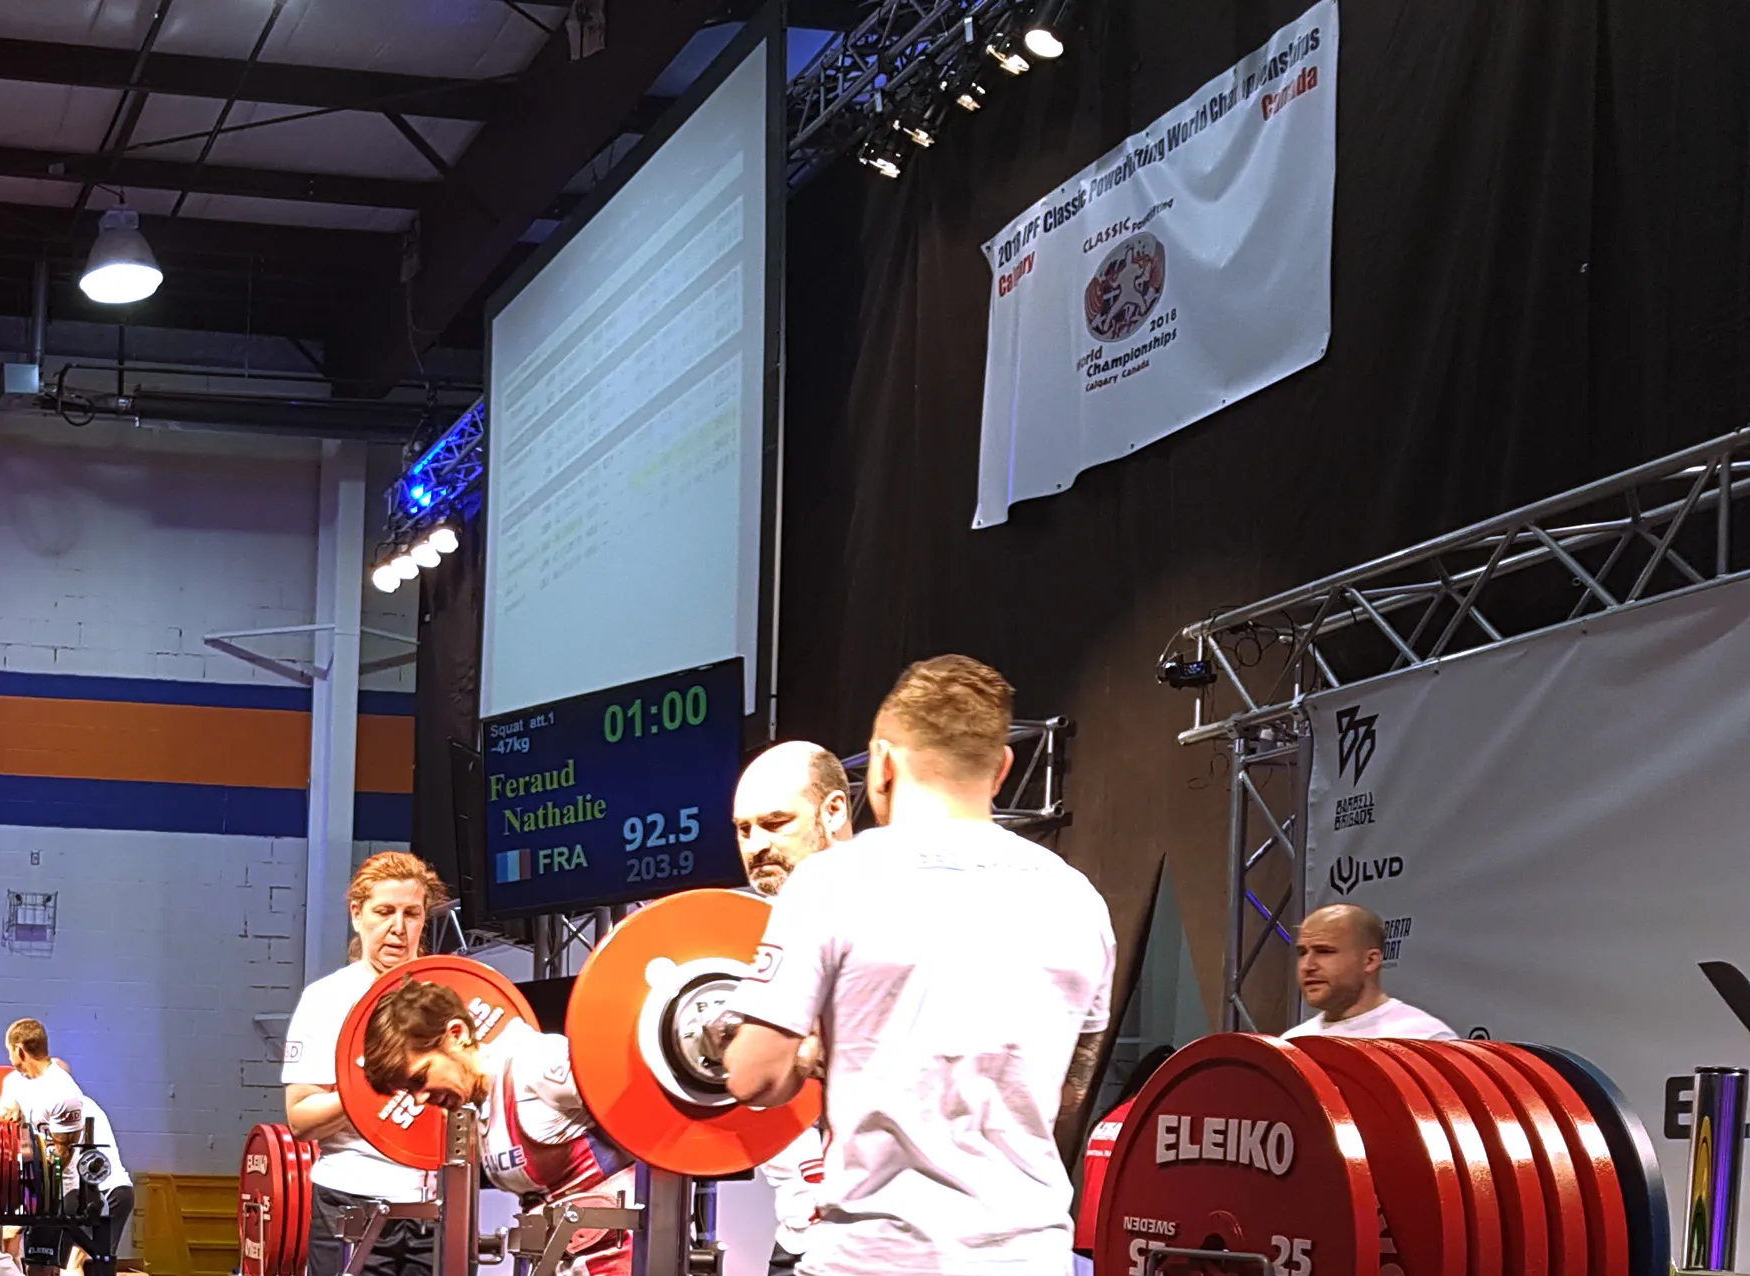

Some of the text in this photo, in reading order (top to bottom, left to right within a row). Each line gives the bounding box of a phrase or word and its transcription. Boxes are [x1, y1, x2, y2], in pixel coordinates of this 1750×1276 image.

[1022, 216, 1041, 247] IPF
[1043, 188, 1087, 233] Classic
[1167, 104, 1208, 152] World
[1082, 216, 1131, 254] CLASSIC
[1150, 308, 1178, 333] 2018
[1086, 328, 1178, 378] Championships
[1085, 373, 1119, 392] Calgary
[490, 711, 555, 738] Squat att.1
[604, 685, 708, 742] 01:00
[490, 736, 530, 754] -47kg
[489, 758, 576, 801] Feraud
[502, 793, 607, 836] Nathalie
[622, 806, 700, 852] 92.5
[538, 843, 589, 875] FRA
[626, 850, 695, 883] 203.9
[1362, 856, 1404, 882] LVD
[1384, 917, 1412, 938] BERTA
[483, 1146, 526, 1171] ANCE
[1156, 1114, 1294, 1176] ELEIKO
[1123, 1215, 1176, 1236] SWEDEN
